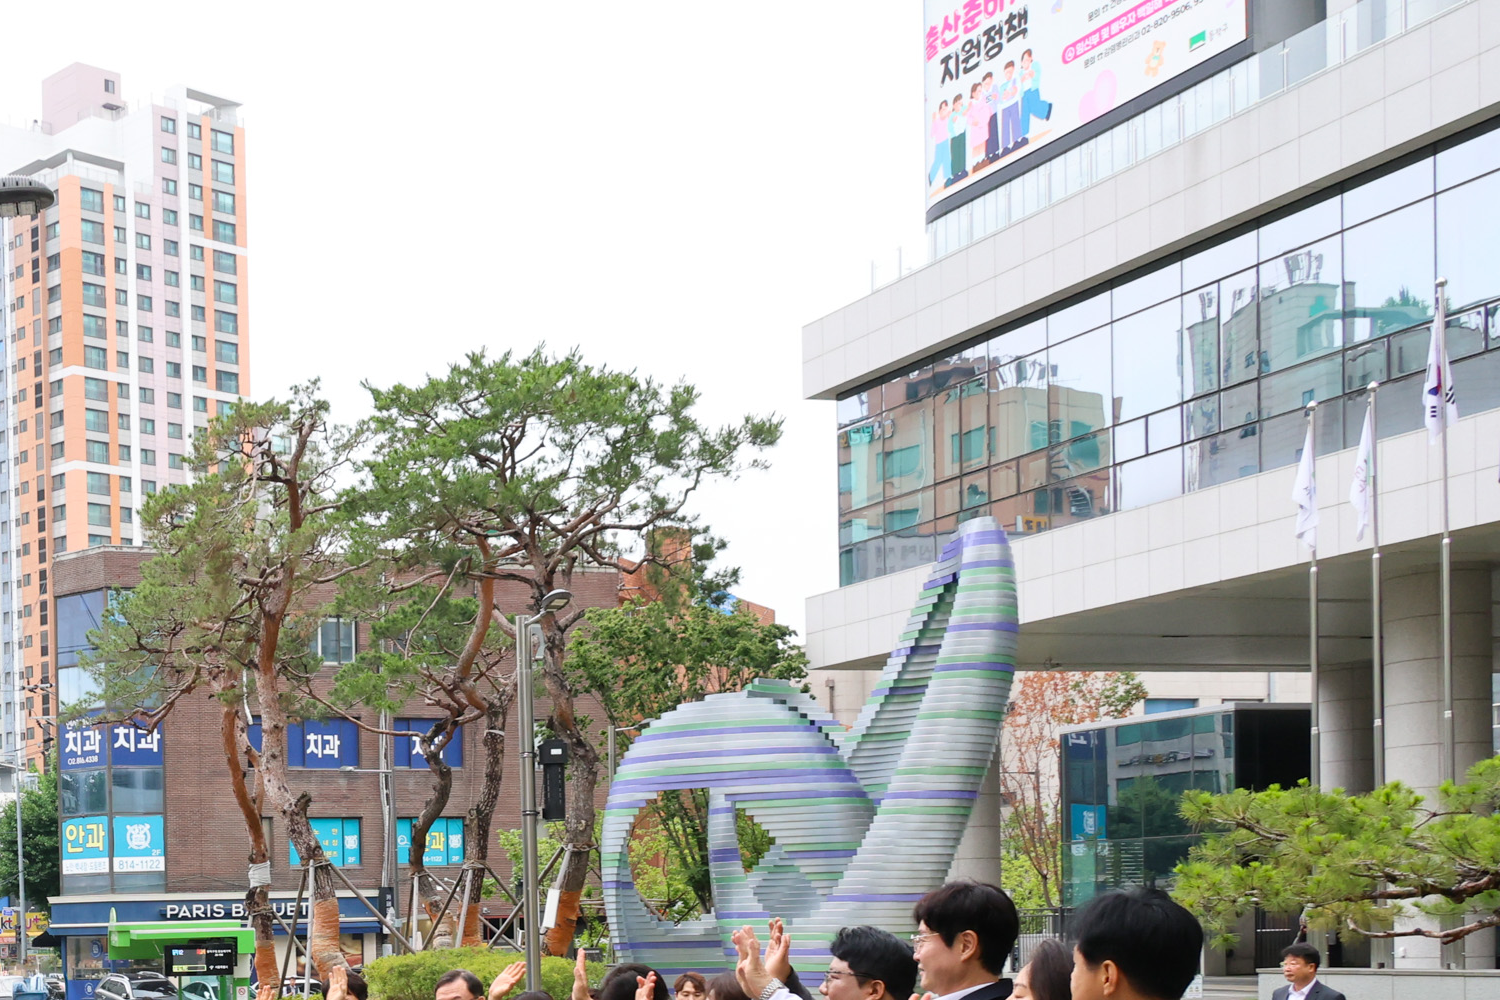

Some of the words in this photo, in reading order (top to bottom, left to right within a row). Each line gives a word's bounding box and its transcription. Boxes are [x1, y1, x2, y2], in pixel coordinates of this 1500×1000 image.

[940, 5, 1028, 88] 지원정책
[64, 730, 102, 755] 치과
[113, 726, 161, 752] 치과
[306, 732, 341, 758] 치과
[65, 823, 106, 853] 안과
[118, 859, 161, 870] 814-1122
[151, 848, 162, 856] 2F
[1, 916, 12, 930] kt
[166, 904, 224, 918] PARIS
